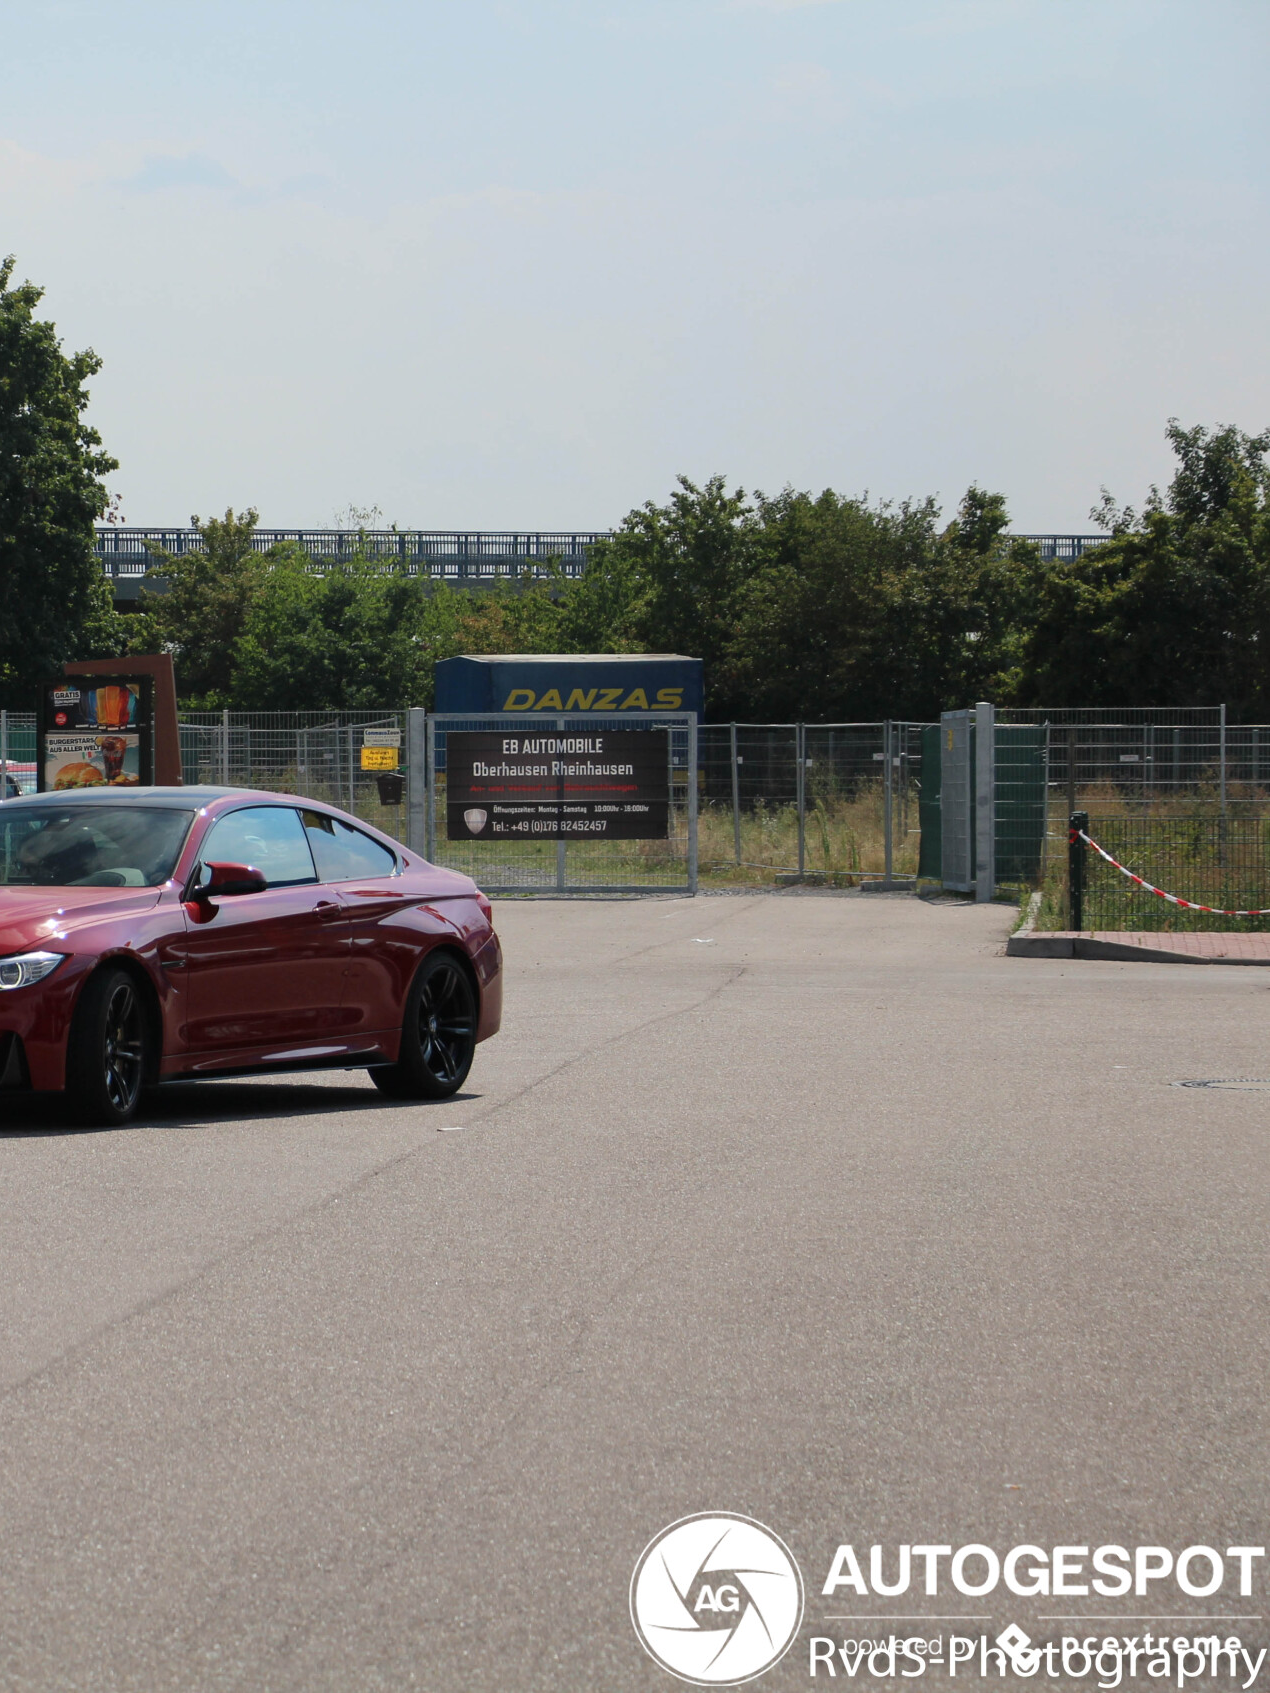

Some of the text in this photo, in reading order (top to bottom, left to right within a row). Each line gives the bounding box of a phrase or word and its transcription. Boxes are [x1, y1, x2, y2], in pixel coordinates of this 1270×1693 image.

[502, 688, 684, 711] DANZAS
[503, 739, 603, 754] EB AUTOMOBILE
[473, 761, 633, 777] Oberhausen Rheinhausen
[538, 806, 558, 814] Montag
[563, 805, 587, 814] Samstag
[492, 820, 607, 833] Tel.: +49 (0)176 82452457
